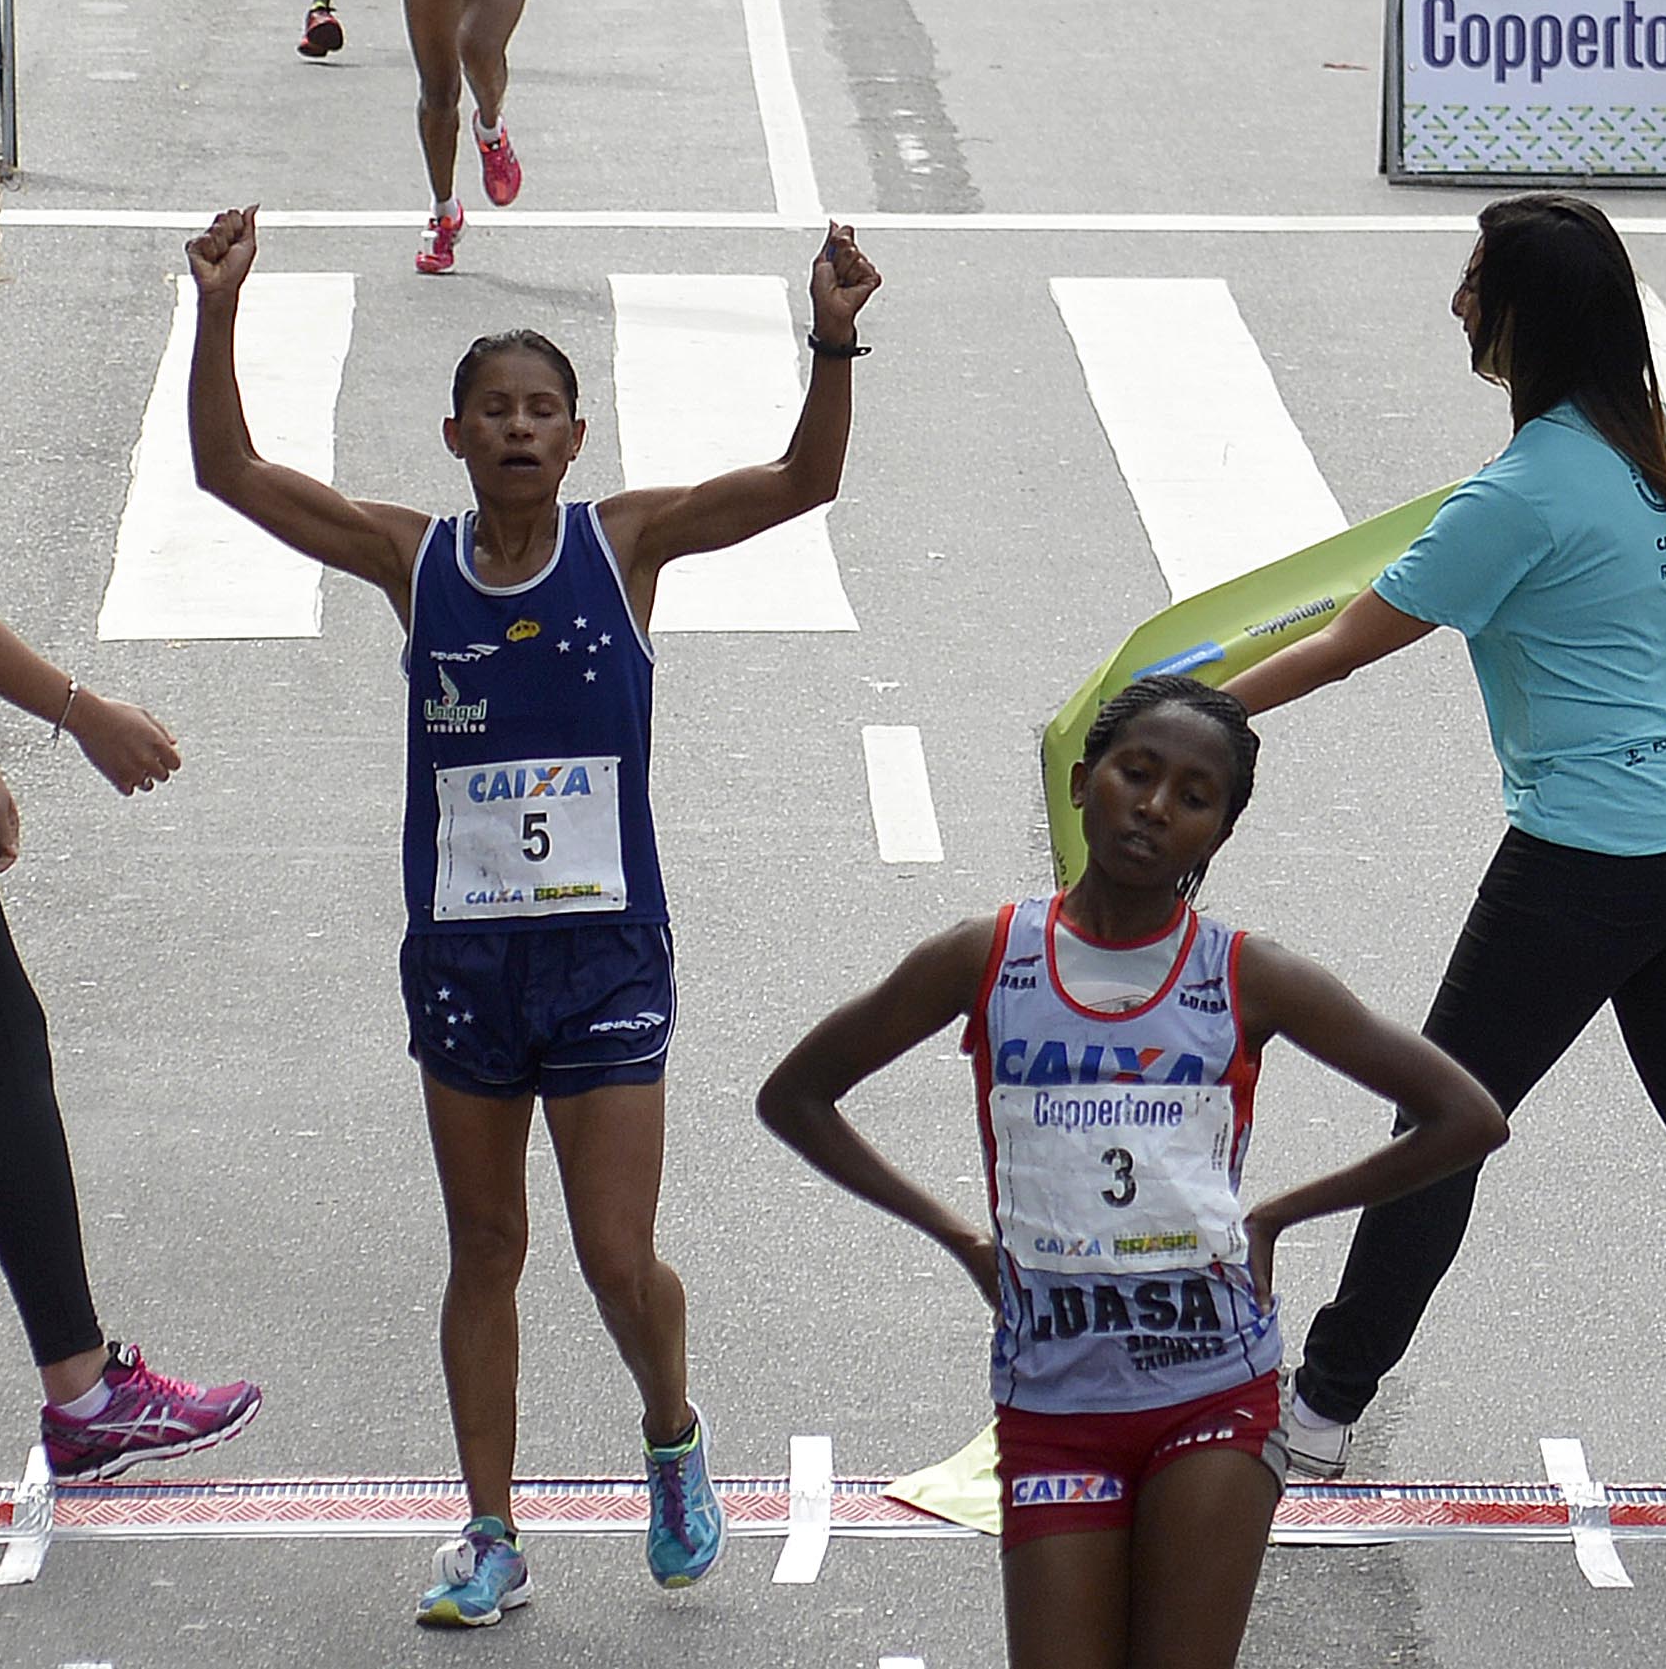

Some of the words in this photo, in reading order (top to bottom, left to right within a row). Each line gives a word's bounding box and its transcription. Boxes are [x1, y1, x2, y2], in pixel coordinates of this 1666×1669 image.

[467, 765, 592, 804] CAIXA
[521, 811, 552, 863] 5
[465, 888, 524, 905] CAIXA
[533, 883, 601, 901] BRASIL
[1178, 991, 1229, 1014] LUASA
[995, 1038, 1206, 1086] CAIXA
[1034, 1091, 1184, 1132] Coppertone
[1100, 1146, 1137, 1208] 3
[1034, 1236, 1102, 1258] CAIXA
[1022, 1278, 1223, 1342] LUASA
[1014, 1474, 1122, 1504] CAIXA
